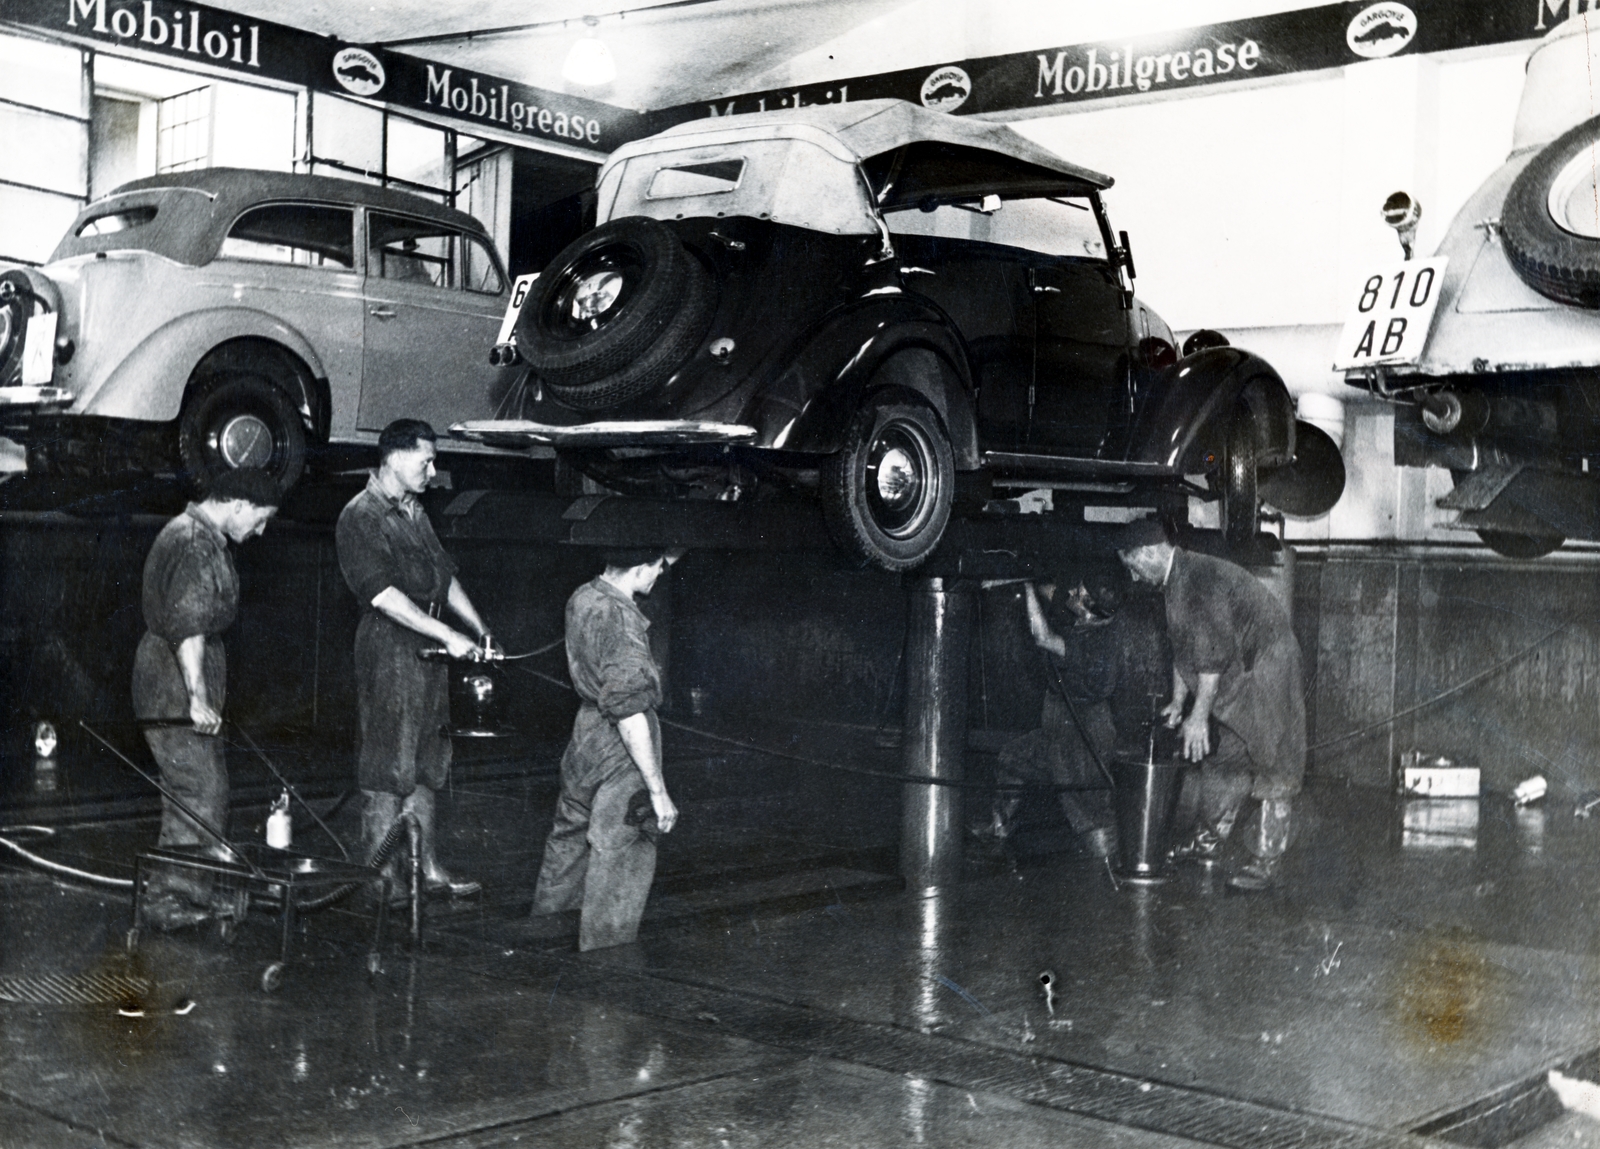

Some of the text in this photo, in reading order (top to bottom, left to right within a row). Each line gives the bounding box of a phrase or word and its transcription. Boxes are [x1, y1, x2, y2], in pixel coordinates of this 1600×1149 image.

[67, 0, 261, 67] Mobiloil
[1360, 9, 1405, 28] GARGOYLE
[1034, 39, 1260, 98] Mobilgrease
[424, 64, 601, 144] Mobilgrease
[1358, 267, 1435, 313] 810
[1353, 317, 1408, 358] AB
